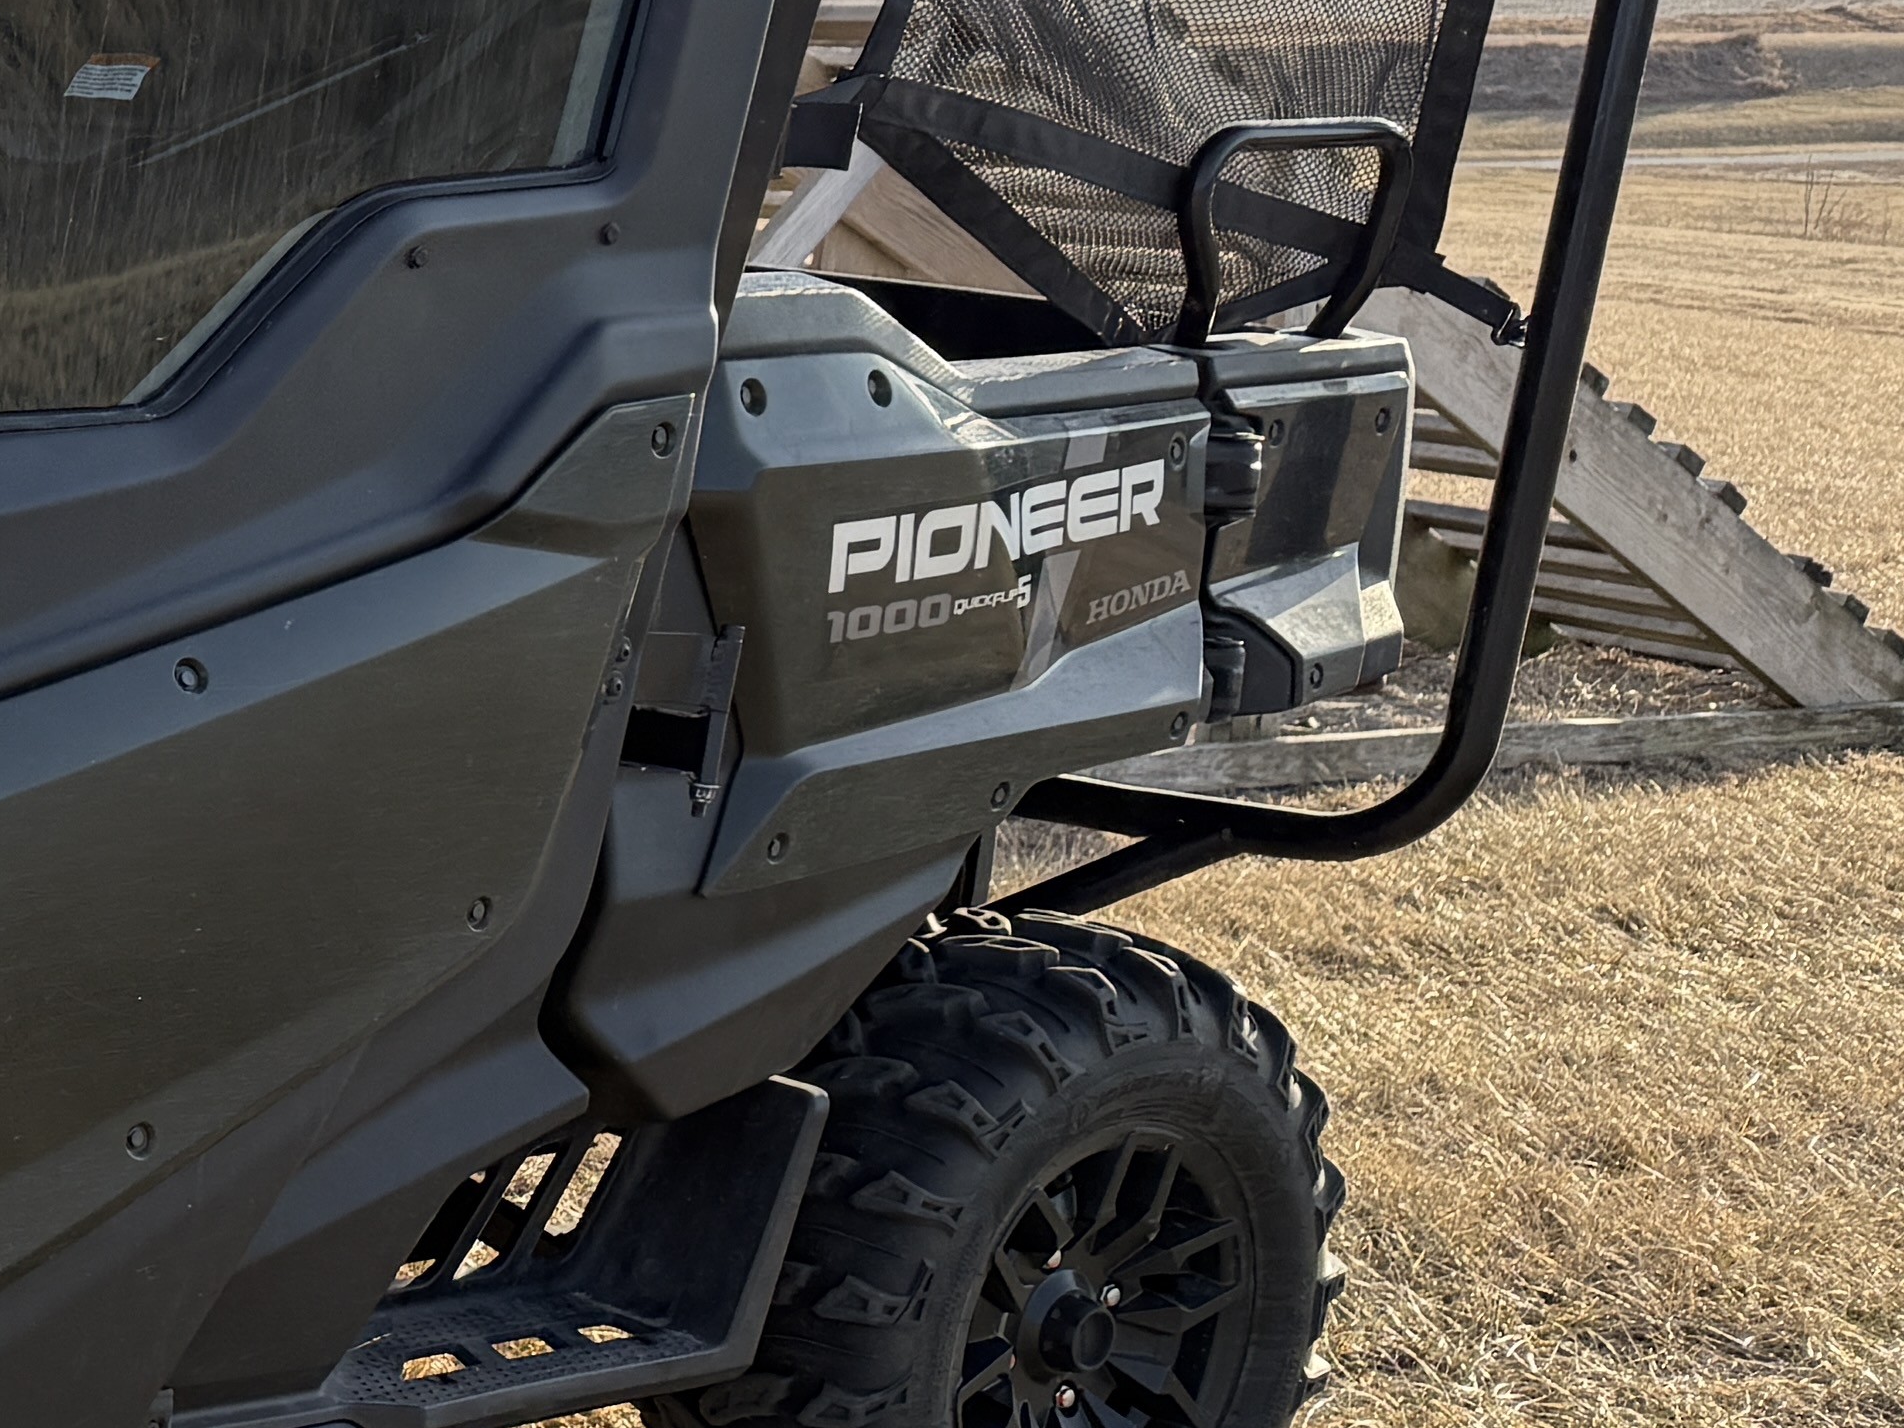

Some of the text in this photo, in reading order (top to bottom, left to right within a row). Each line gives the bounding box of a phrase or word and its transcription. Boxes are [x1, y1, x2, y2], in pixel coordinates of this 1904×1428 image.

[827, 458, 1165, 595] PIONEER
[826, 593, 952, 644] 1000
[1085, 569, 1192, 625] HONDA
